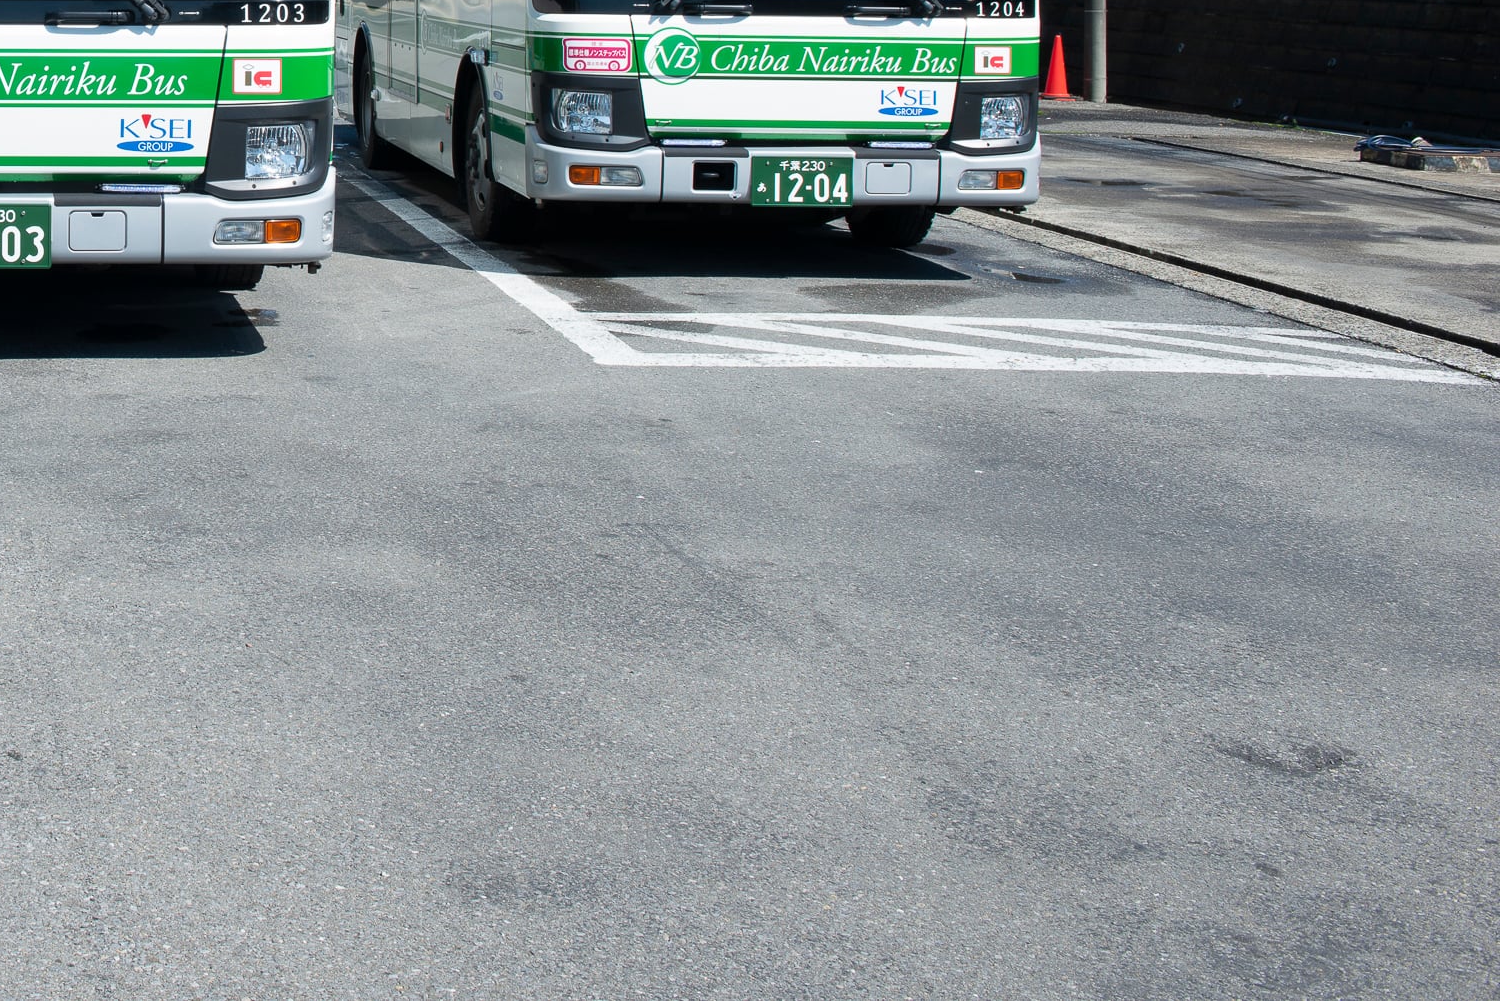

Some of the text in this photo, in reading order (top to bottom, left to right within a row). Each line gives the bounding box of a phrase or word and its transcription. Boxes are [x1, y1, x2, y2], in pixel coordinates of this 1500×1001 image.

[240, 3, 306, 23] 1203
[975, 1, 1025, 17] 1204
[710, 44, 957, 73] Chiba Nairiku Bus
[127, 63, 188, 96] Bus
[895, 107, 923, 116] GROUP
[138, 141, 173, 152] GROUP
[757, 172, 848, 203] あ 12-04
